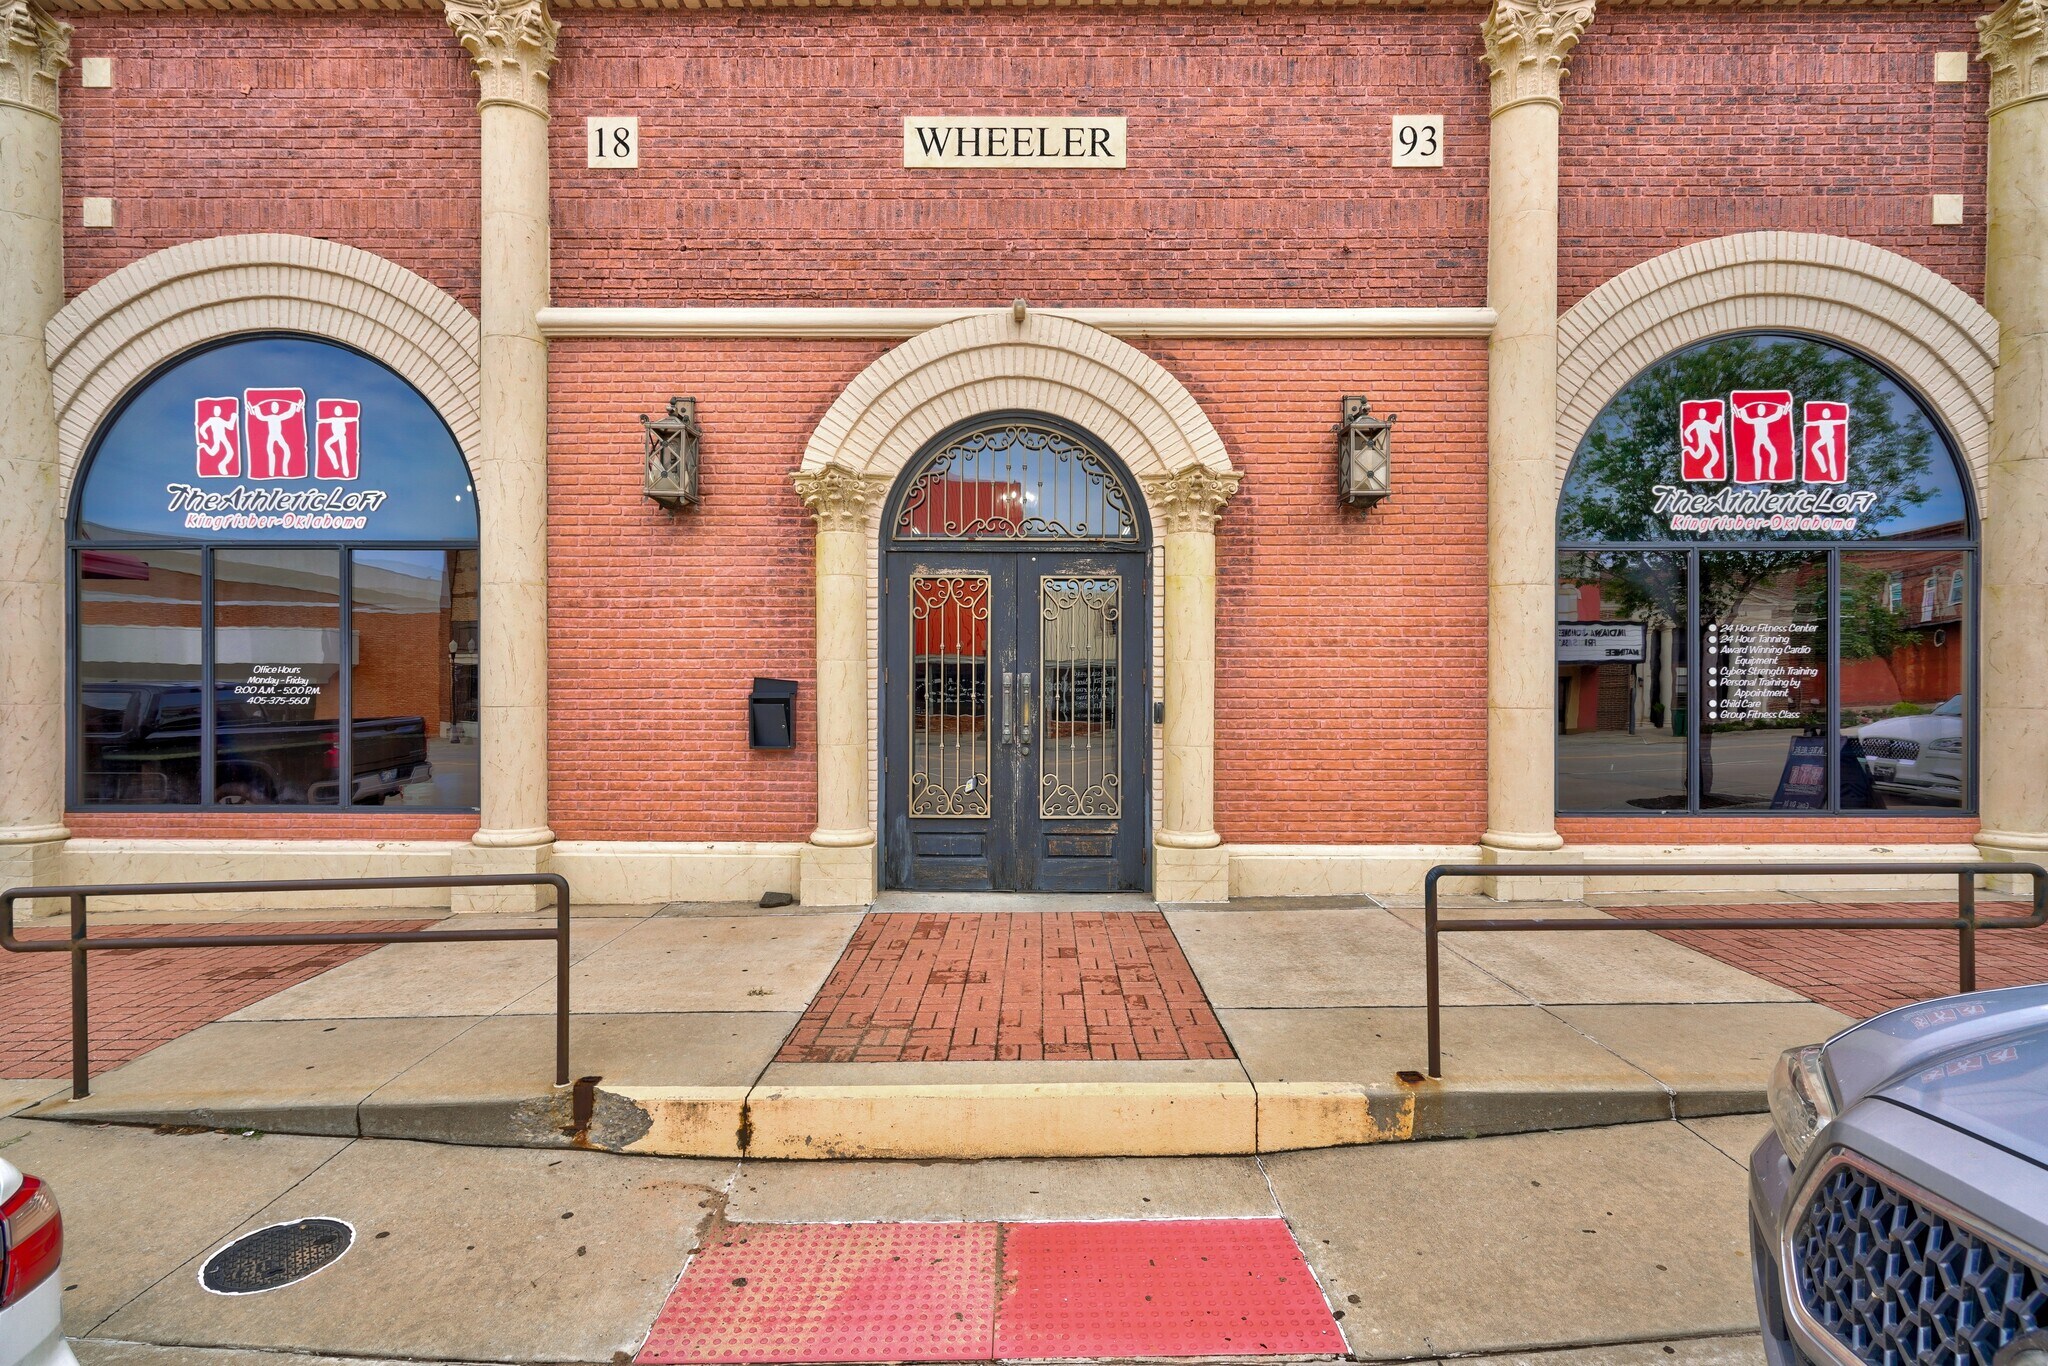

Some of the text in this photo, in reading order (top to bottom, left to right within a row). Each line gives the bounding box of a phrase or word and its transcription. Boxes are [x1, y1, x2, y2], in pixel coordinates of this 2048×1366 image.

[595, 127, 630, 158] 18
[914, 127, 1116, 157] WHEELER
[1399, 125, 1437, 156] 93
[1720, 623, 1819, 633] 24 Hour Fitness Center
[1720, 634, 1790, 645] 24 Hour Tanning
[1720, 645, 1811, 655] Award Winning Cardio
[1735, 656, 1779, 666] Equipment
[252, 665, 301, 674] Office Hours
[1720, 666, 1819, 677] Cybex Strength Training
[247, 676, 280, 687] Monday
[285, 676, 309, 687] Friday
[1720, 678, 1801, 689] Personal Training by
[234, 686, 257, 694] 8:00
[282, 686, 305, 695] 5:00
[1733, 689, 1790, 698] Appointment
[246, 696, 311, 705] 405-375-5601
[1720, 699, 1761, 708] Child Care
[1720, 710, 1801, 720] Group Fitness Class
